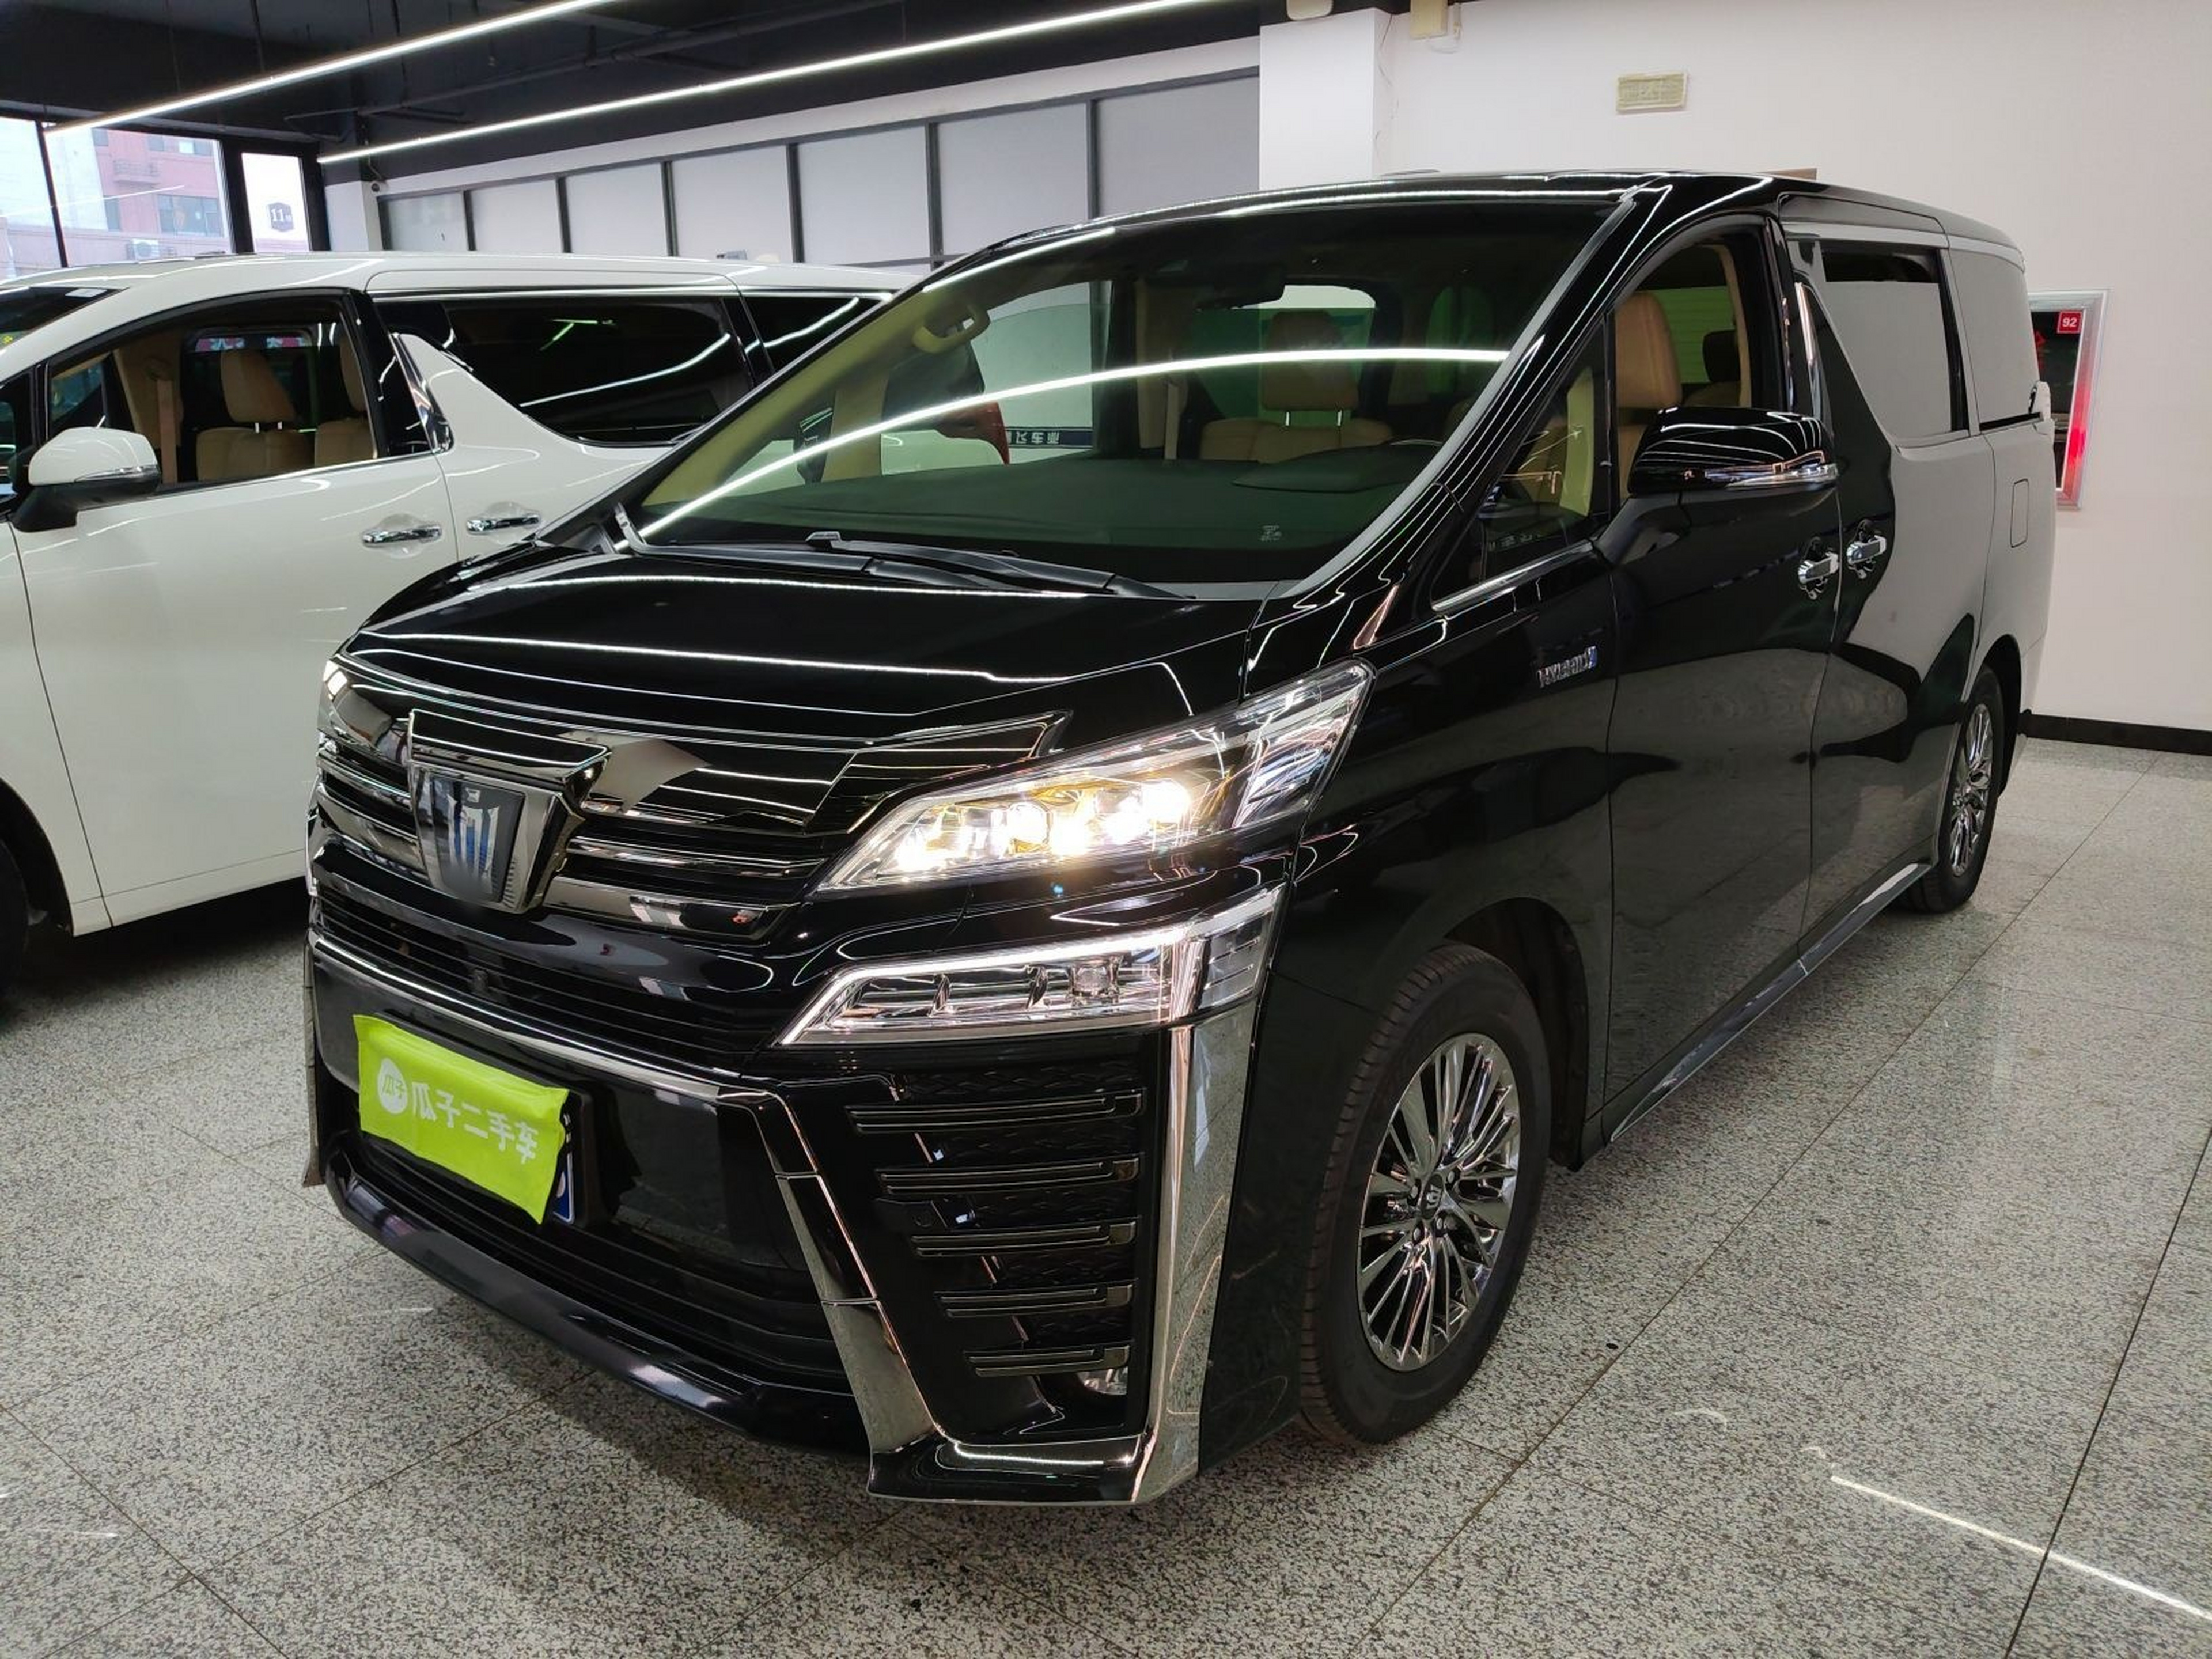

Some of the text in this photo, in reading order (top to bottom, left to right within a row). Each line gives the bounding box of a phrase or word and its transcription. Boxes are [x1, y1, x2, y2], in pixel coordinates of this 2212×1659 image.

[2062, 317, 2077, 327] 92
[1006, 431, 1059, 444] 飞车业
[412, 1081, 539, 1165] 瓜子二手车
